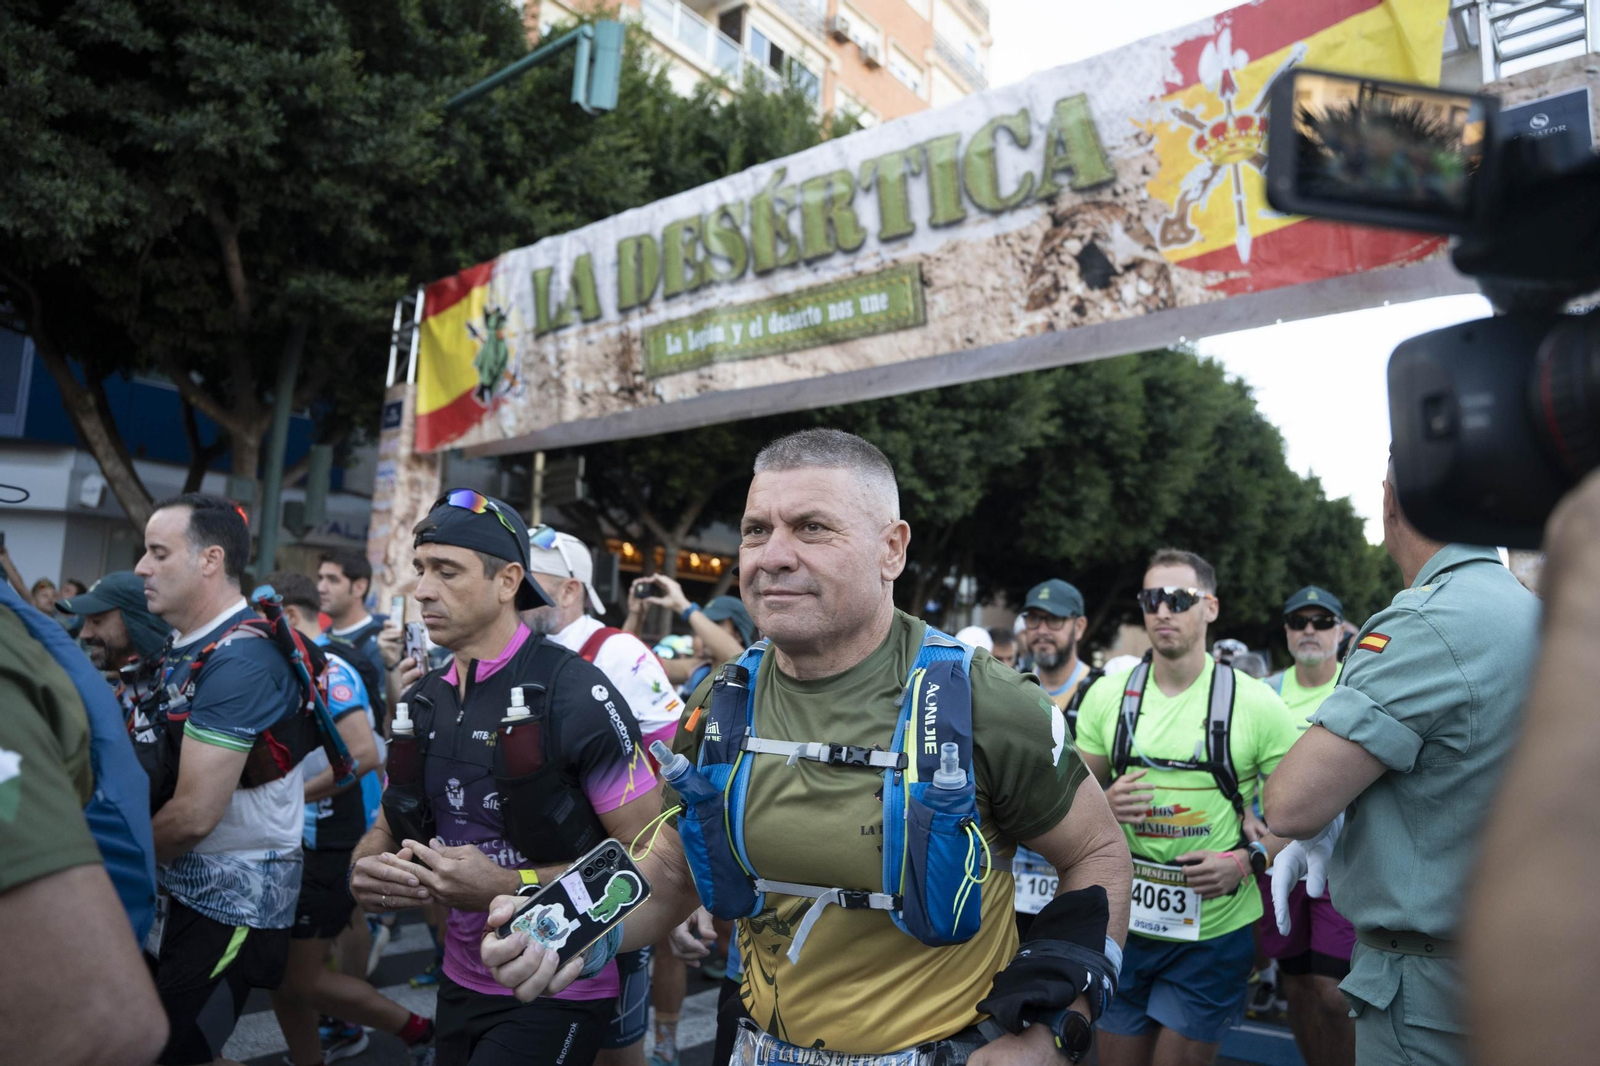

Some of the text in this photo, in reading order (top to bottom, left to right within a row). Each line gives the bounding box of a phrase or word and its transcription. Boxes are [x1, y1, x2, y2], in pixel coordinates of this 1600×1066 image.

[532, 92, 1117, 338] LA DESÉRTICA
[666, 333, 682, 355] La
[731, 323, 743, 345] y
[749, 314, 763, 338] el
[768, 306, 822, 335] desierto
[828, 300, 854, 322] nos
[859, 292, 889, 315] une
[604, 701, 634, 755] Espabrok
[923, 681, 940, 755] AONIJIE
[860, 825, 876, 836] LA
[1152, 805, 1174, 818] LOS
[1132, 882, 1186, 914] 4063
[1134, 919, 1160, 932] asisa
[556, 1021, 578, 1065] Espabrok
